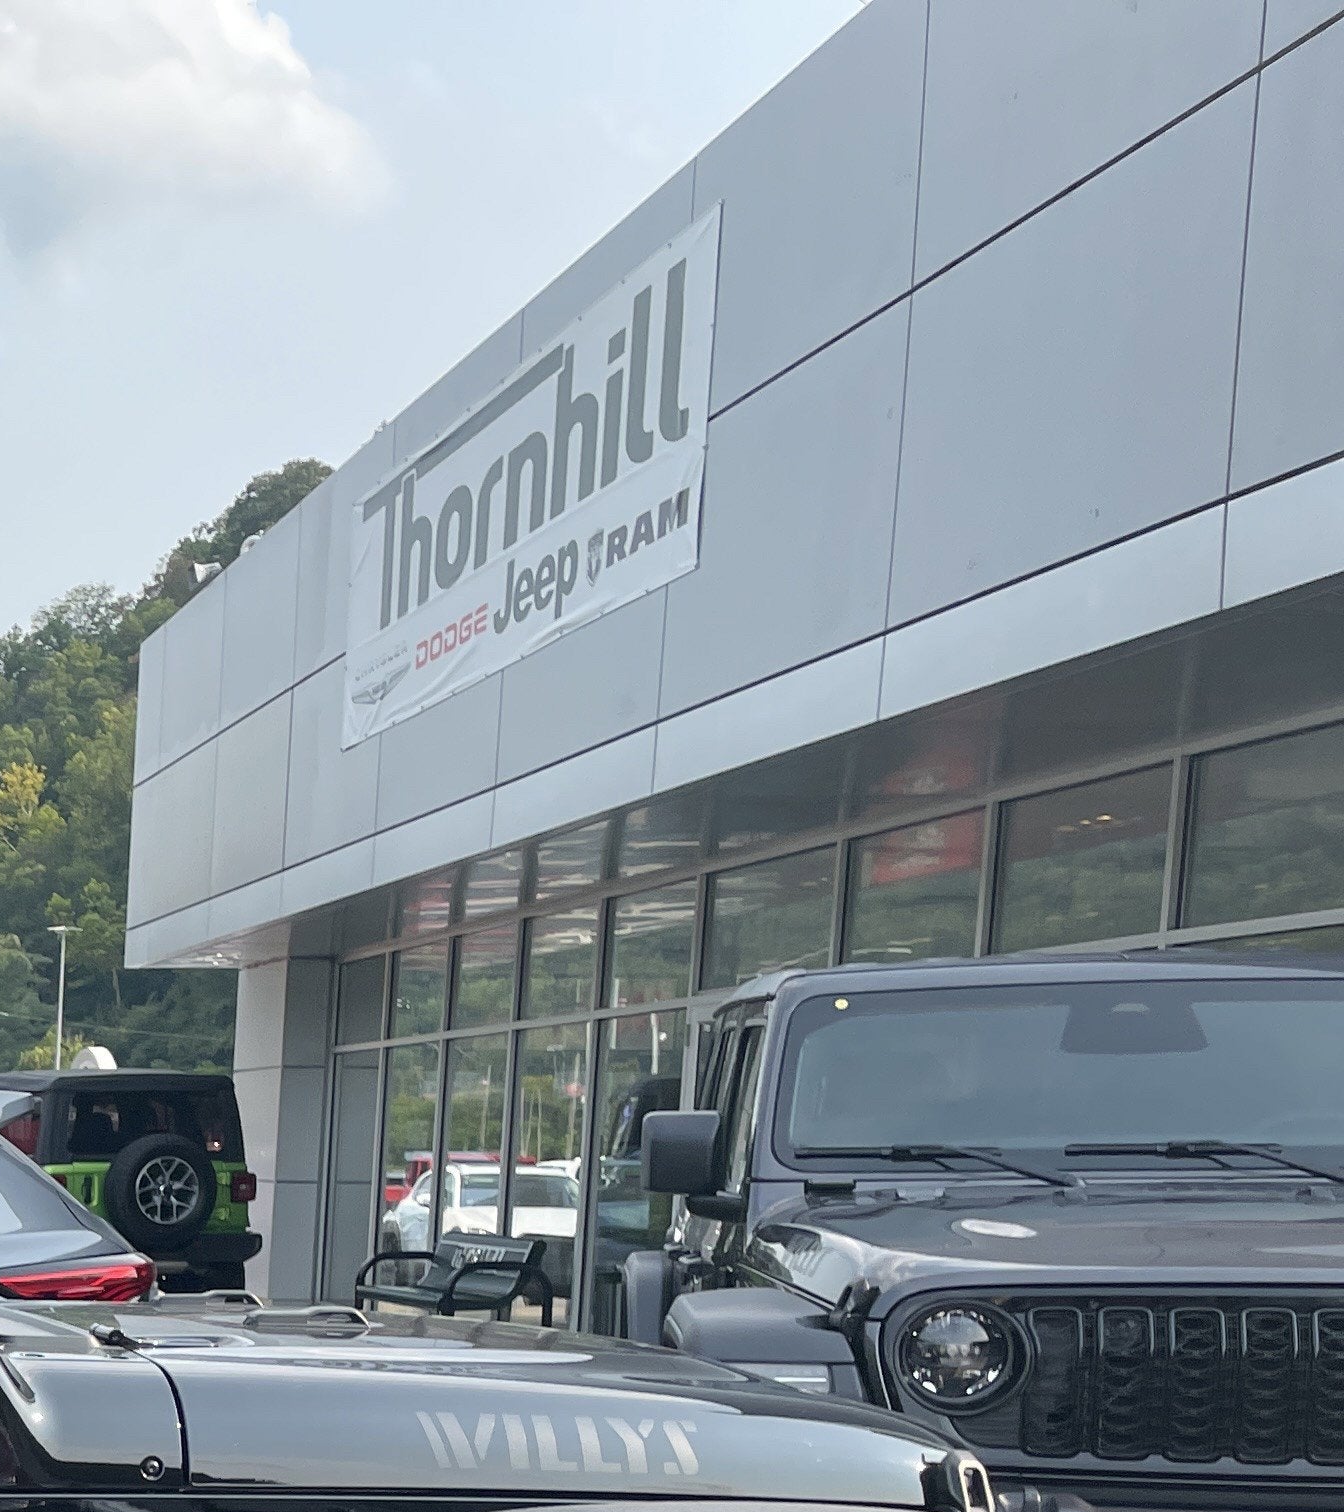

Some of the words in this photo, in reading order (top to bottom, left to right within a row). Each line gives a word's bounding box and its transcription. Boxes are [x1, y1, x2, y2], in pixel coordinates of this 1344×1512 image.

[363, 257, 688, 630] Thornhill
[415, 602, 489, 670] DODGE
[493, 539, 578, 634] Jeep
[606, 487, 689, 568] RAM
[416, 1411, 699, 1475] WILLYS
